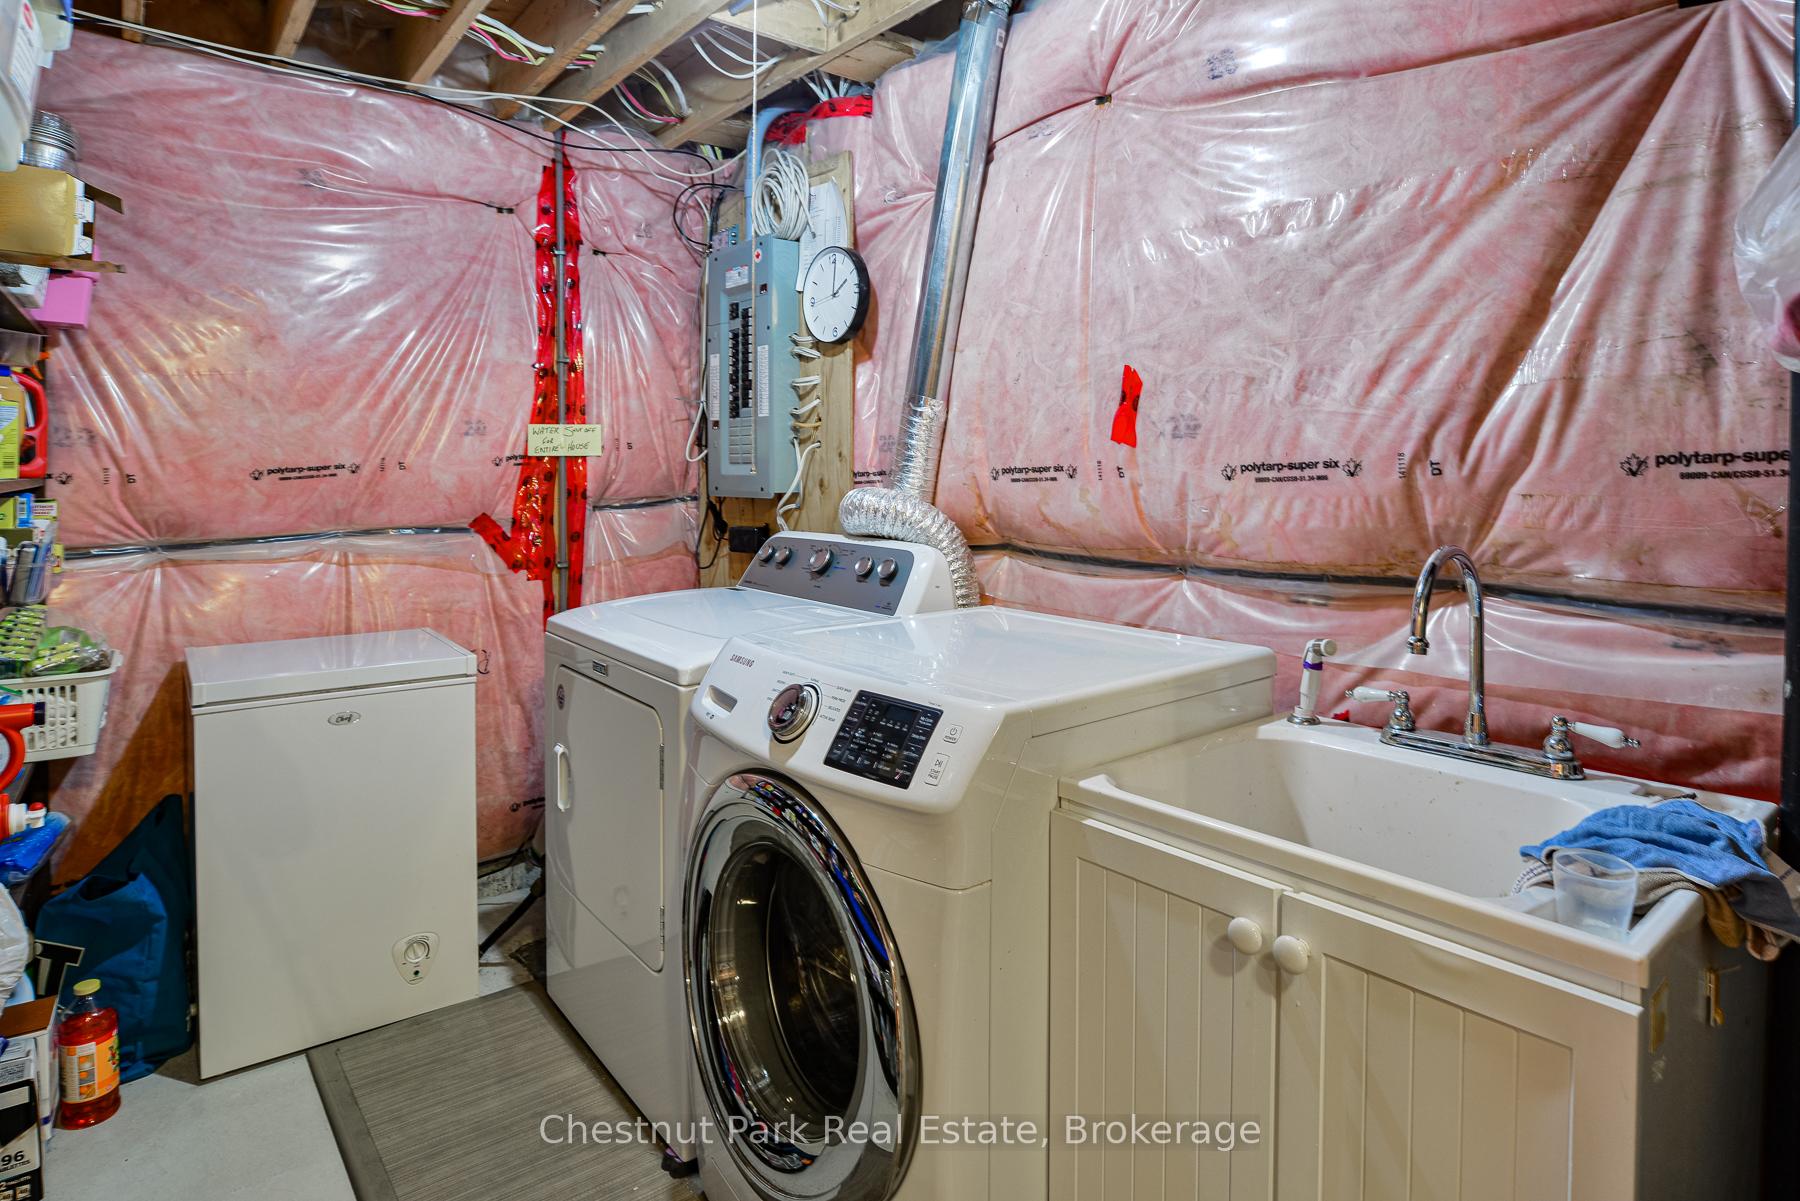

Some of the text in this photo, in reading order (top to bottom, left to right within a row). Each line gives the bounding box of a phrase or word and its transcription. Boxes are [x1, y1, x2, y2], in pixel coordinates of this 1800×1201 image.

[809, 297, 816, 307] 9
[831, 326, 838, 338] 6
[568, 441, 590, 452] HOUSE
[267, 462, 346, 476] polytarp-super six
[1001, 464, 1065, 476] polytarp-super six
[1240, 458, 1340, 474] polytarp-super six
[1429, 459, 1443, 476] DT
[730, 653, 755, 668] SAMSUNG
[1, 1150, 25, 1167] 96
